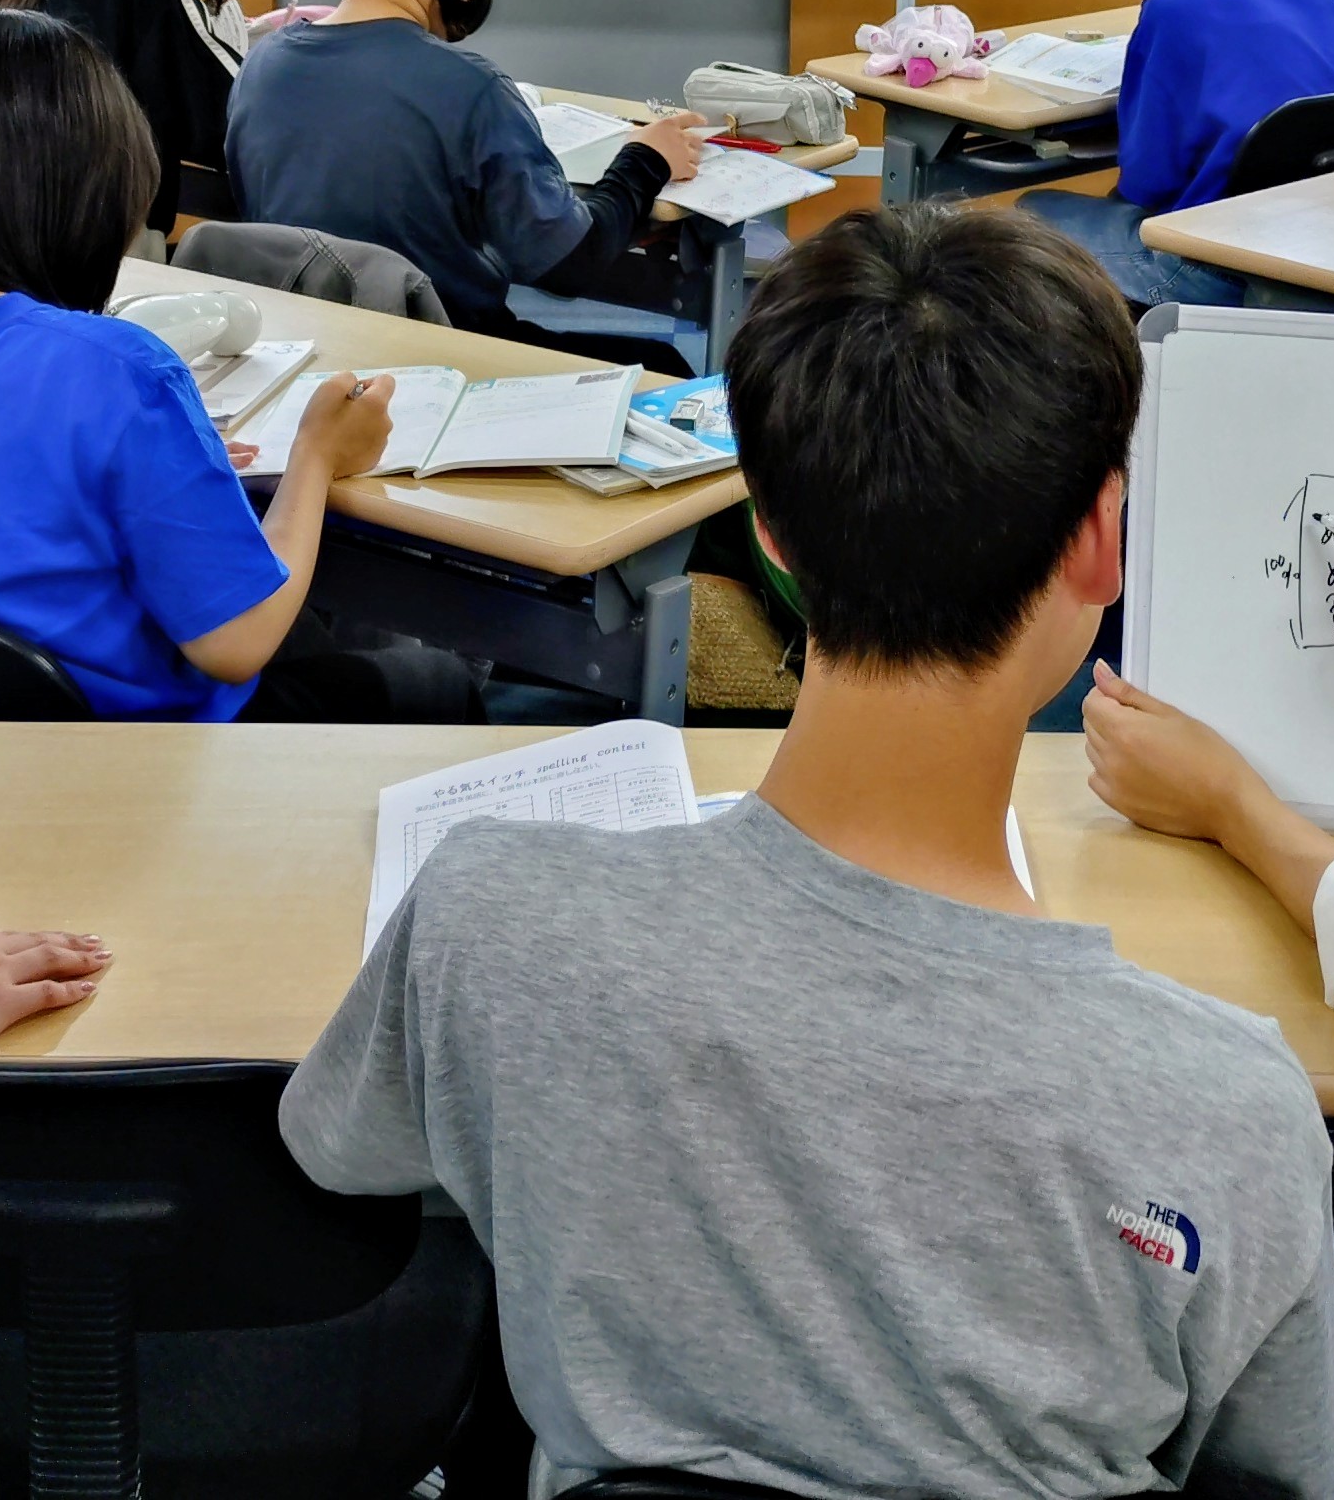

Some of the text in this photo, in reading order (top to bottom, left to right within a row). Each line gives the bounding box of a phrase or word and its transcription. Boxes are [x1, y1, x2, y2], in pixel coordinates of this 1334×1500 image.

[597, 741, 646, 757] contest
[1105, 1203, 1175, 1245] NORTH
[1146, 1200, 1177, 1227] THE
[1119, 1228, 1168, 1262] FACE
